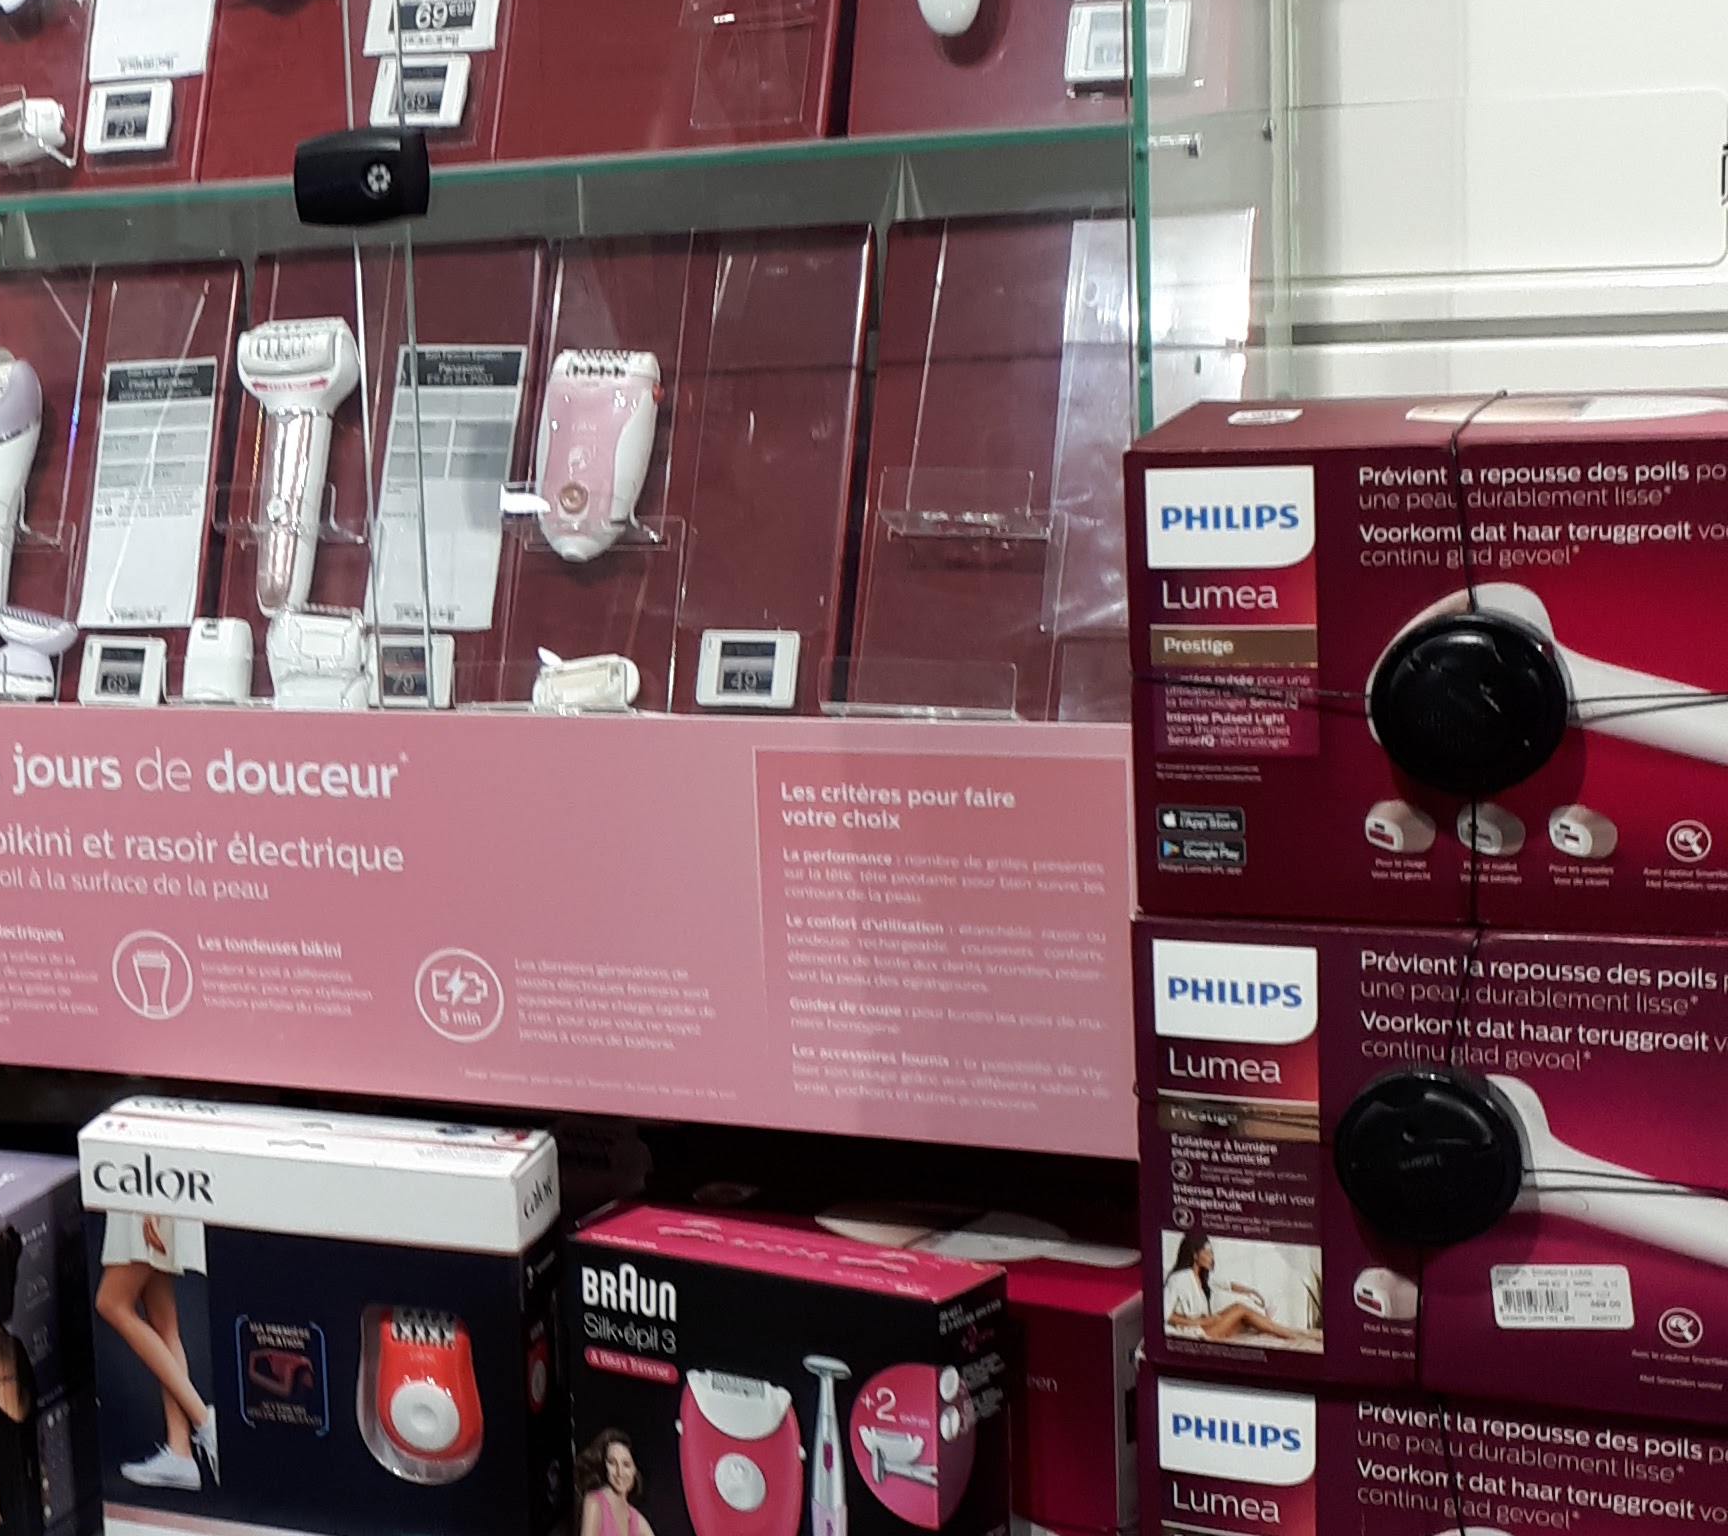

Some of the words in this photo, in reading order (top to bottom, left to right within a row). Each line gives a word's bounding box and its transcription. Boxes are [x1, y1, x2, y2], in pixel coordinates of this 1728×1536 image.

[1359, 465, 1448, 486] Prévient
[1480, 467, 1582, 488] repousse
[1587, 465, 1628, 484] des
[1635, 461, 1689, 485] poils
[1467, 487, 1609, 509] durablement
[1161, 503, 1300, 532] PHILIPS
[1470, 522, 1507, 543] dat
[1513, 522, 1561, 543] haar
[1568, 521, 1692, 545] teruggroeit
[1359, 547, 1440, 567] continu
[1162, 578, 1280, 613] Lumea
[1163, 635, 1234, 656] Prestige
[11, 742, 123, 797] jours
[134, 746, 193, 794] de
[780, 781, 817, 804] Les
[821, 782, 902, 805] critères
[907, 788, 959, 809] pour
[964, 786, 1017, 809] faire
[781, 807, 837, 828] votre
[842, 809, 901, 830] choix
[81, 830, 116, 861] et
[124, 829, 220, 866] rasoir
[226, 838, 406, 877] électrique
[71, 869, 149, 896] surface
[212, 878, 270, 903] peau
[1360, 949, 1457, 978] Prévient
[1489, 961, 1602, 984] repousse
[1606, 963, 1651, 987] des
[1657, 967, 1718, 991] poils
[1167, 975, 1304, 1010] PHILIPS
[1475, 983, 1629, 1012] durablement
[451, 1008, 482, 1026] min
[1360, 1039, 1445, 1062] continu
[1476, 1017, 1514, 1041] dat
[1520, 1019, 1572, 1043] haar
[1577, 1024, 1710, 1053] teruggroeit
[1168, 1047, 1282, 1085] Lumea
[581, 1263, 677, 1322] BRAUN
[1171, 1412, 1302, 1453] PHILIPS
[1482, 1416, 1591, 1448] repousse
[1595, 1428, 1639, 1453] des
[1644, 1437, 1703, 1462] poils
[1468, 1440, 1619, 1477] durablement
[1171, 1480, 1281, 1525] Lumea
[1356, 1485, 1439, 1512] continu
[1468, 1470, 1507, 1496] dat
[1511, 1475, 1562, 1502] haar
[1567, 1484, 1695, 1521] teruggroeit
